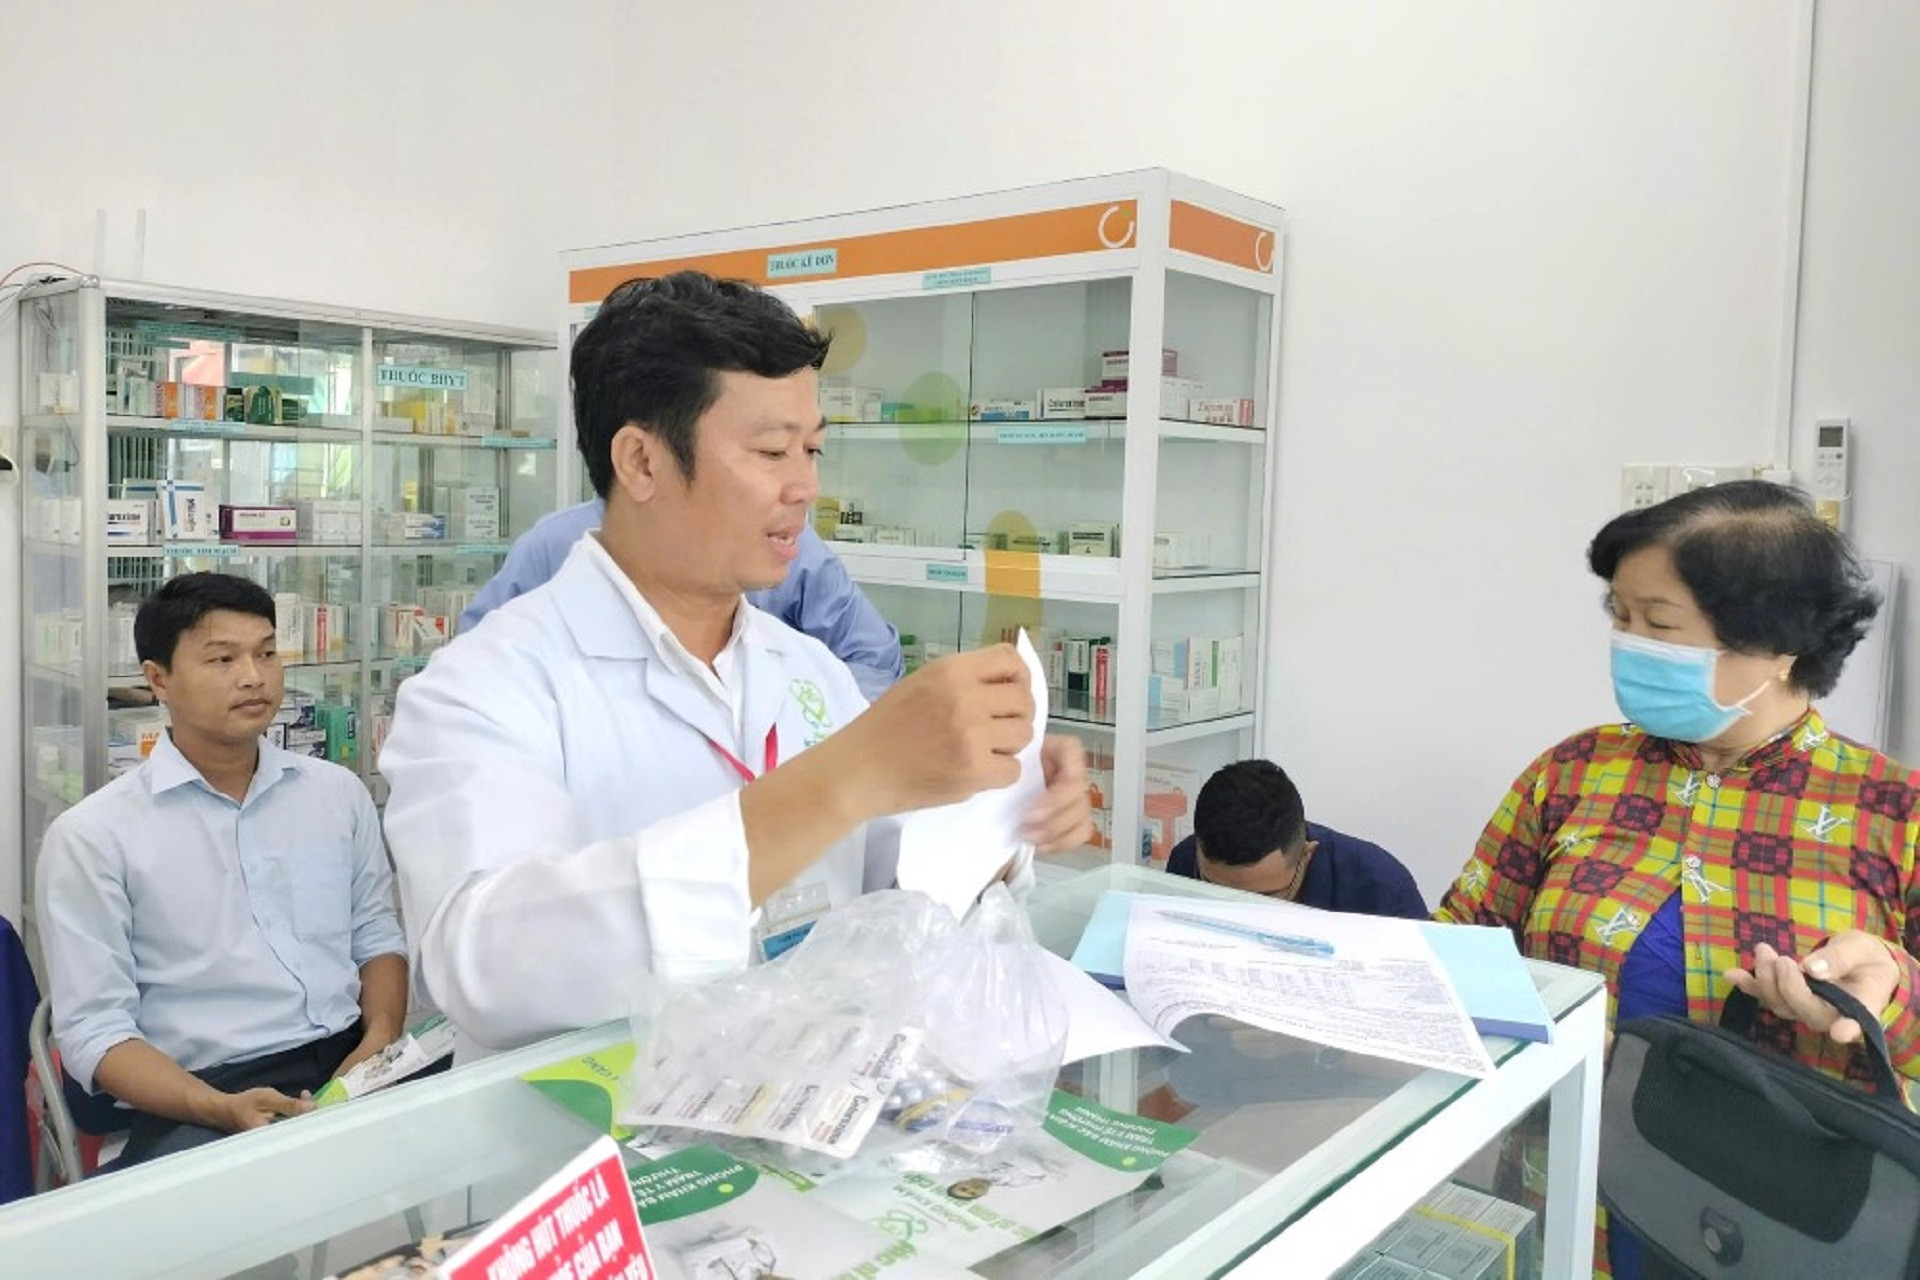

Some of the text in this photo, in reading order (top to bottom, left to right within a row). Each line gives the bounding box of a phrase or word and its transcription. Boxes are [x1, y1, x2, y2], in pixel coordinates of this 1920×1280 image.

[381, 368, 464, 387] THUỐC BHYT
[529, 1214, 559, 1261] HÚT
[553, 1178, 595, 1240] THUỐC
[587, 1166, 610, 1209] LÁ
[595, 1217, 625, 1264] BẠN
